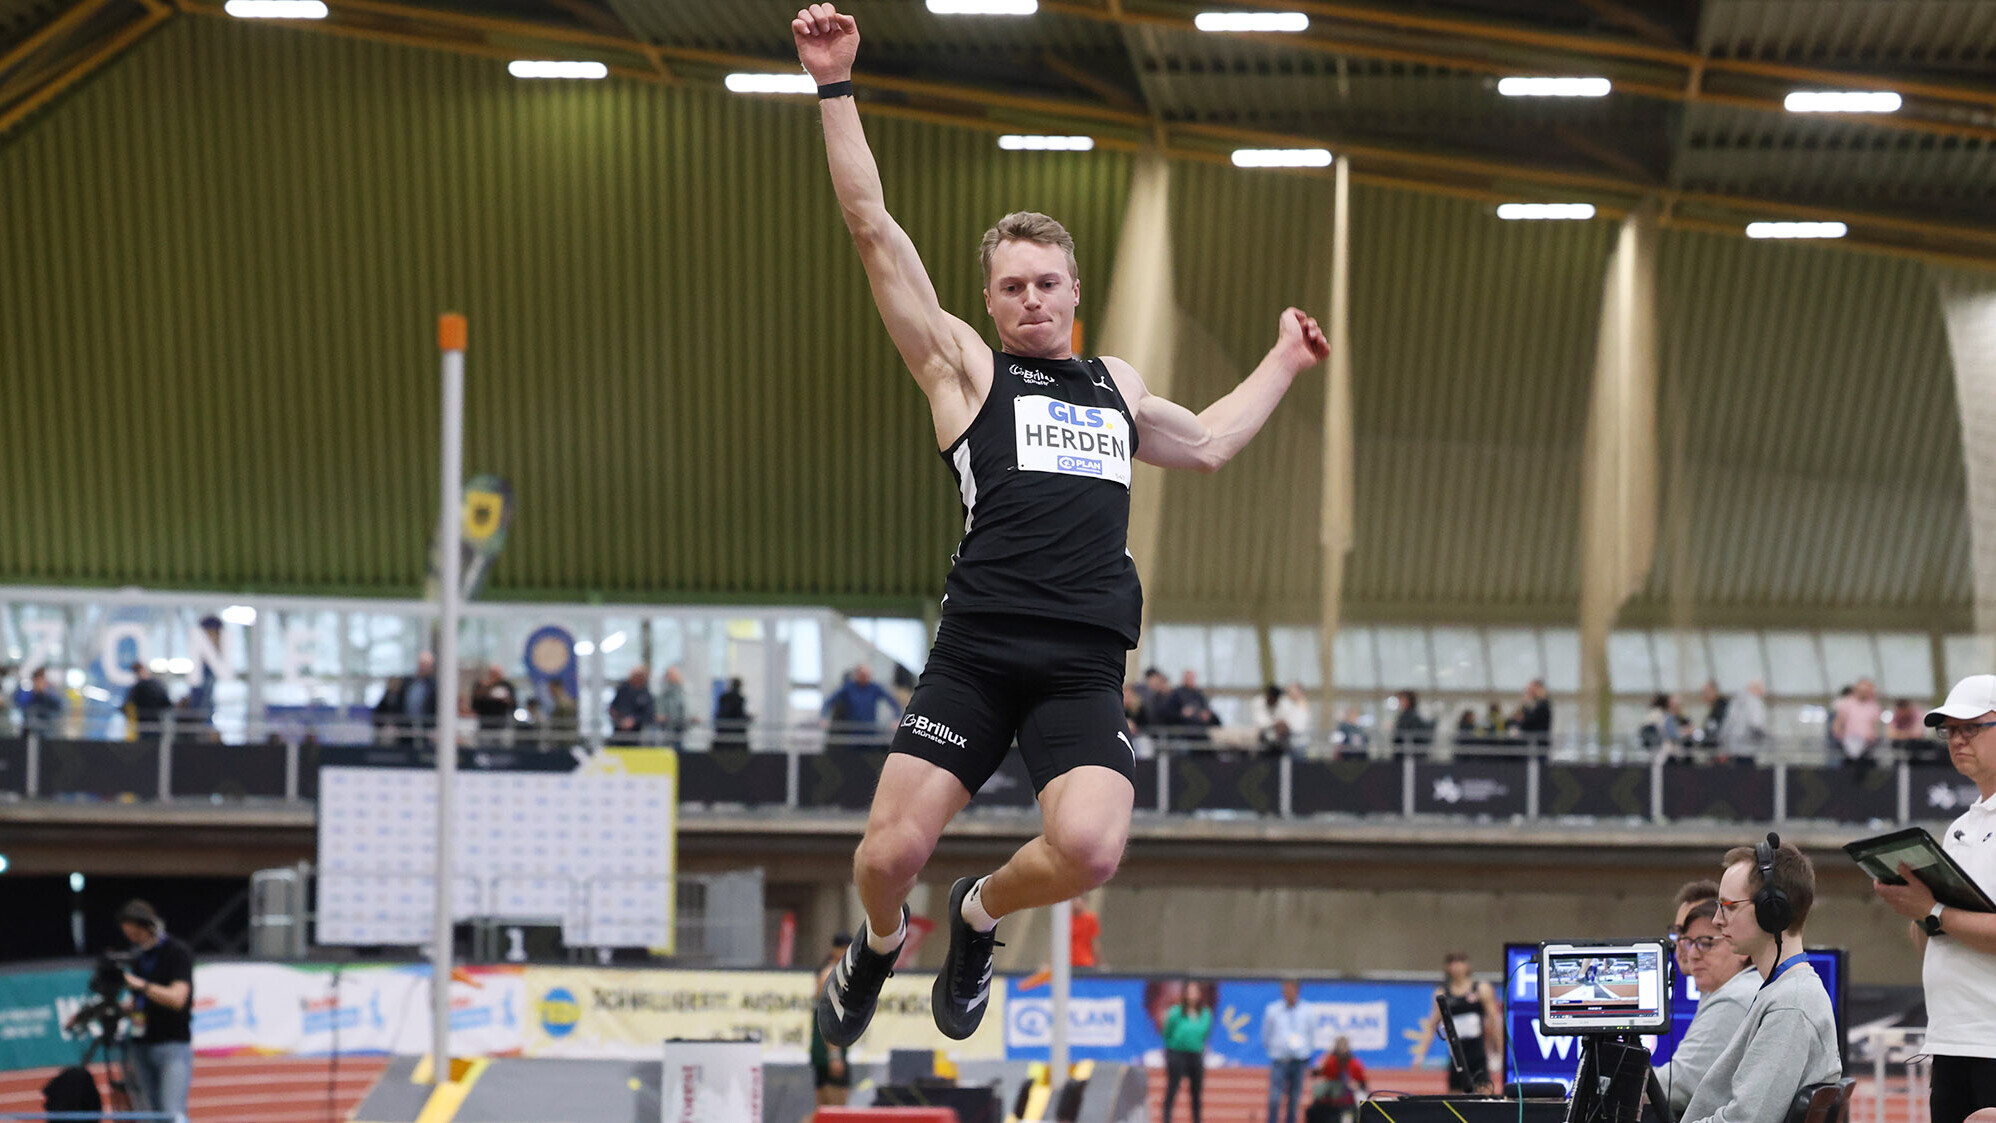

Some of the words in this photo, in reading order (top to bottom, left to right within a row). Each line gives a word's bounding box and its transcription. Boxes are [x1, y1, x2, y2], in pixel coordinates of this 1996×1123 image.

[1026, 424, 1125, 461] HERDEN
[1076, 460, 1101, 470] PLAN
[912, 728, 946, 745] Münster
[915, 715, 967, 748] Brillux
